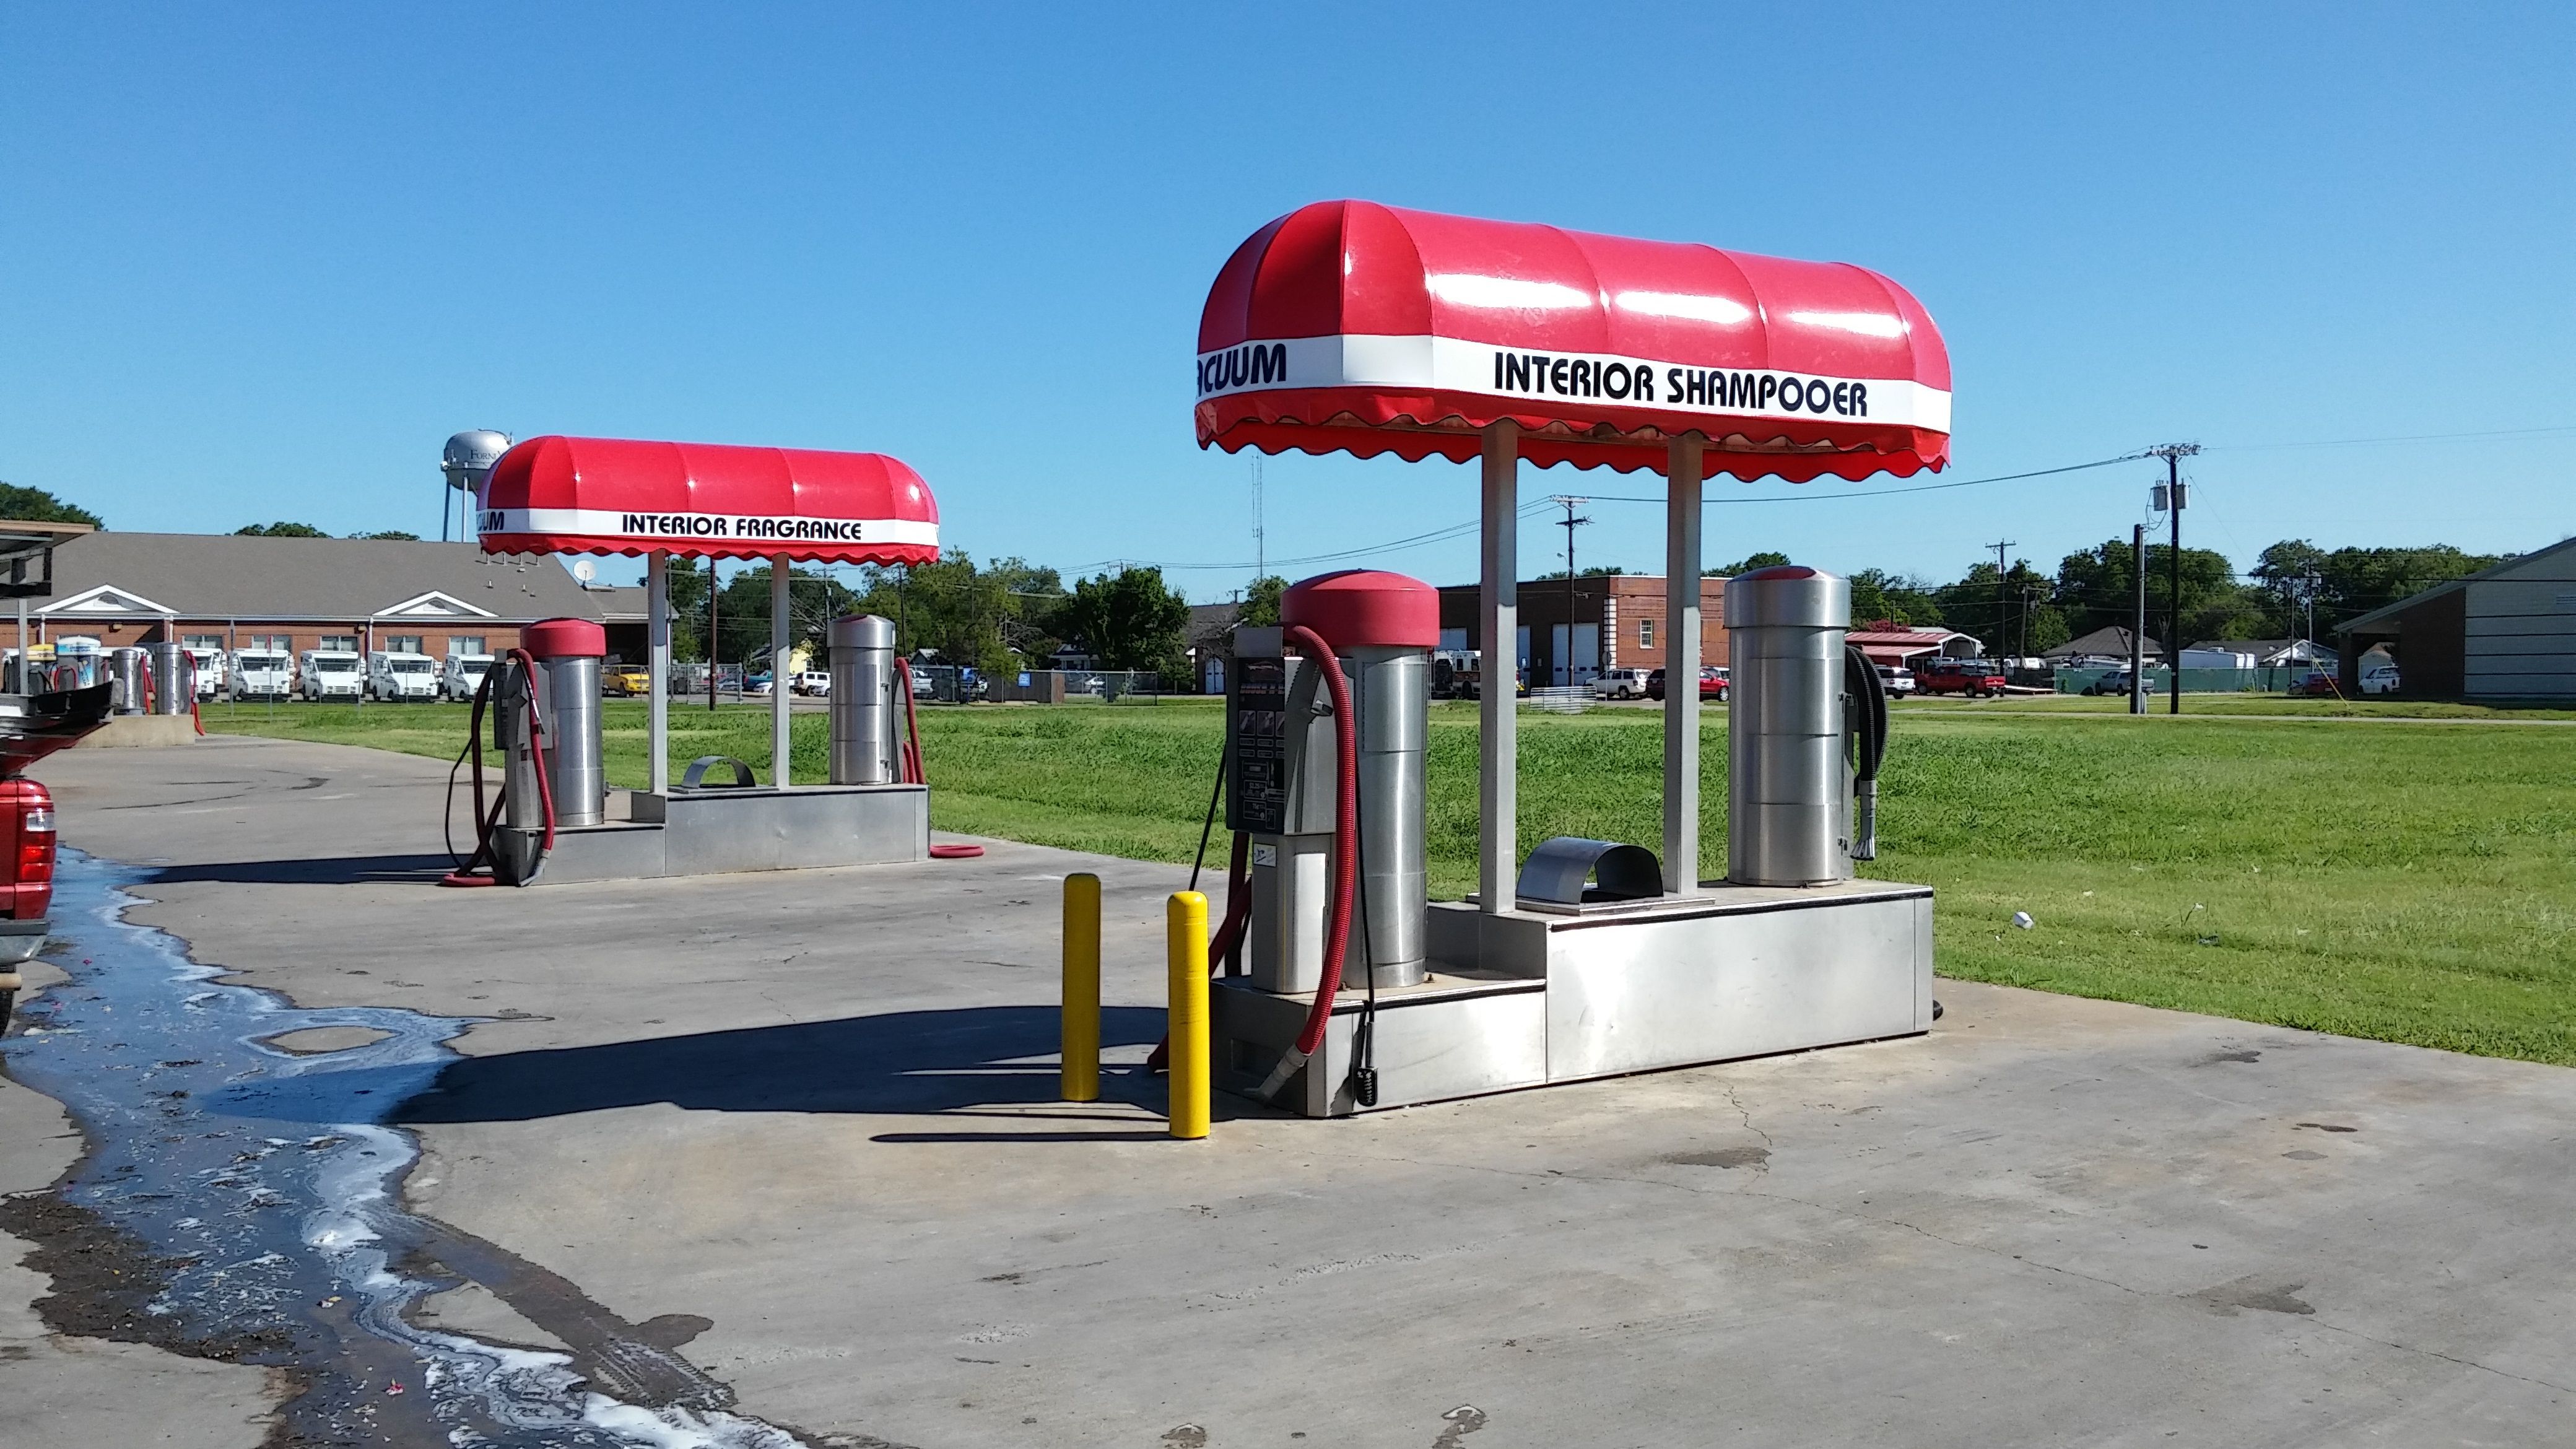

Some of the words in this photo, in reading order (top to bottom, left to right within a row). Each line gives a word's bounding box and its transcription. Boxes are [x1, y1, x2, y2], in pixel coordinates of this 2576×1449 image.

[1198, 344, 1286, 397] ACUUM
[1495, 352, 1654, 401] INTERIOR
[1667, 368, 1867, 417] SHAMPOOER
[471, 450, 501, 459] FORN
[622, 514, 727, 536] INTERIOR
[736, 518, 861, 540] FRAGRANCE
